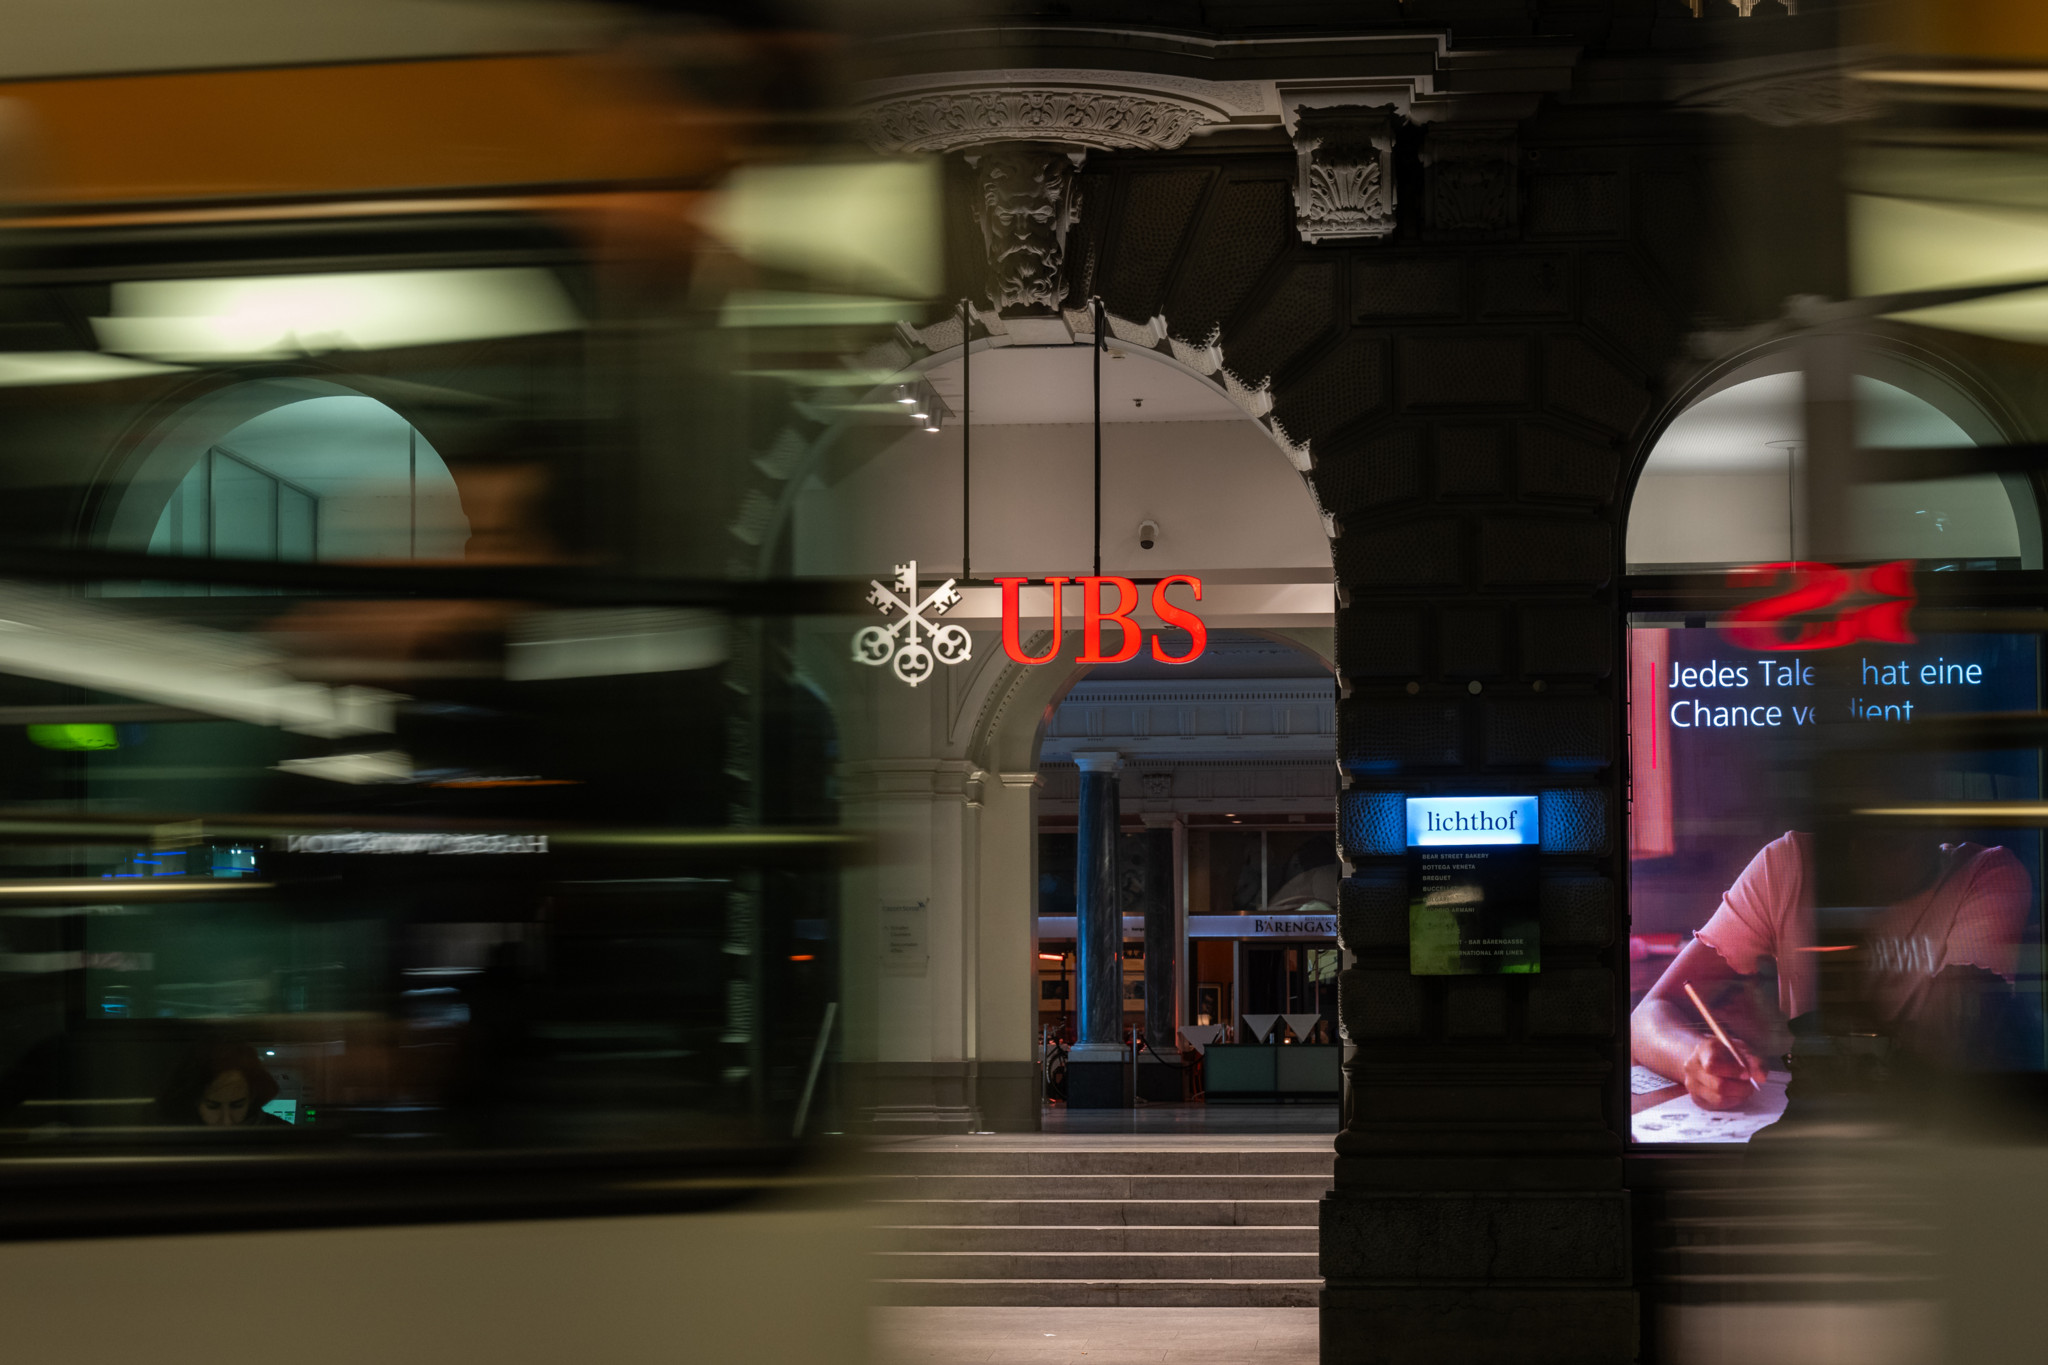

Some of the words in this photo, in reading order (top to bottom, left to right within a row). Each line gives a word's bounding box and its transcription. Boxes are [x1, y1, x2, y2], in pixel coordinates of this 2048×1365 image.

[993, 574, 1207, 665] UBS
[1669, 659, 1749, 688] Jedes
[1758, 658, 1816, 687] Tale
[1862, 657, 1911, 686] hat
[1920, 657, 1983, 685] eine
[1671, 699, 1782, 728] Chance
[1427, 810, 1518, 831] lichthof
[1255, 916, 1338, 933] BÄRENGASS
